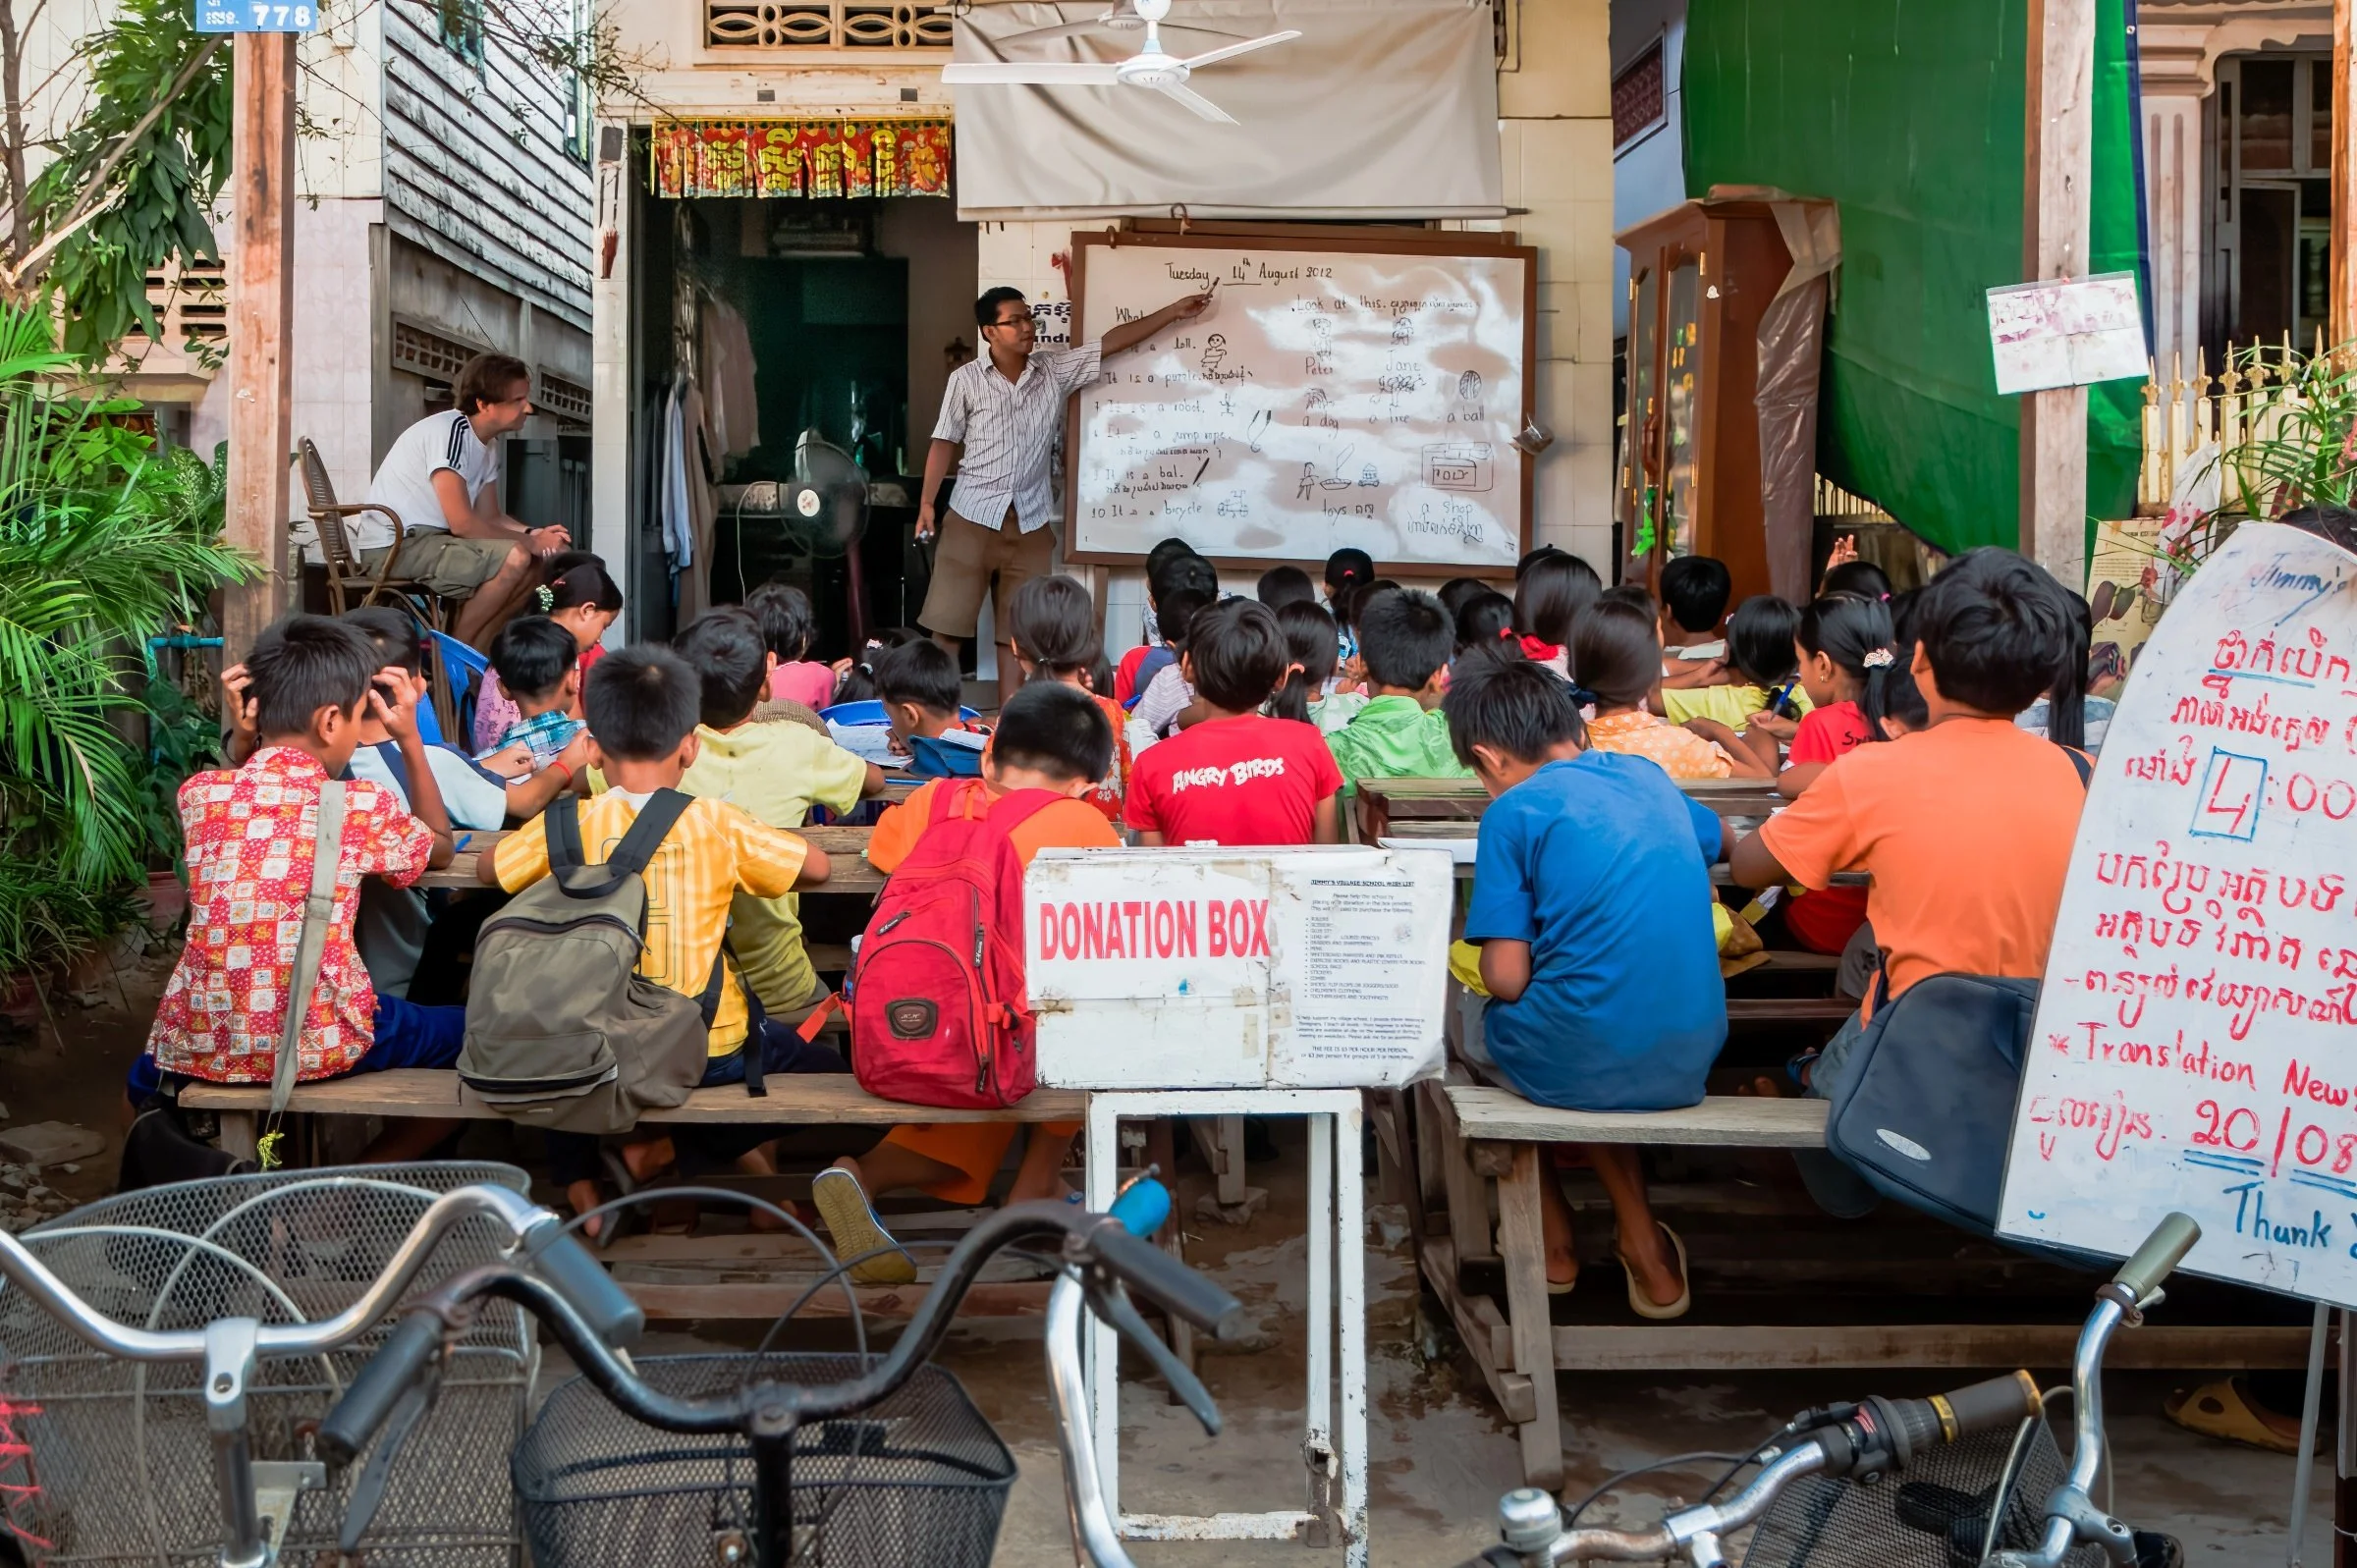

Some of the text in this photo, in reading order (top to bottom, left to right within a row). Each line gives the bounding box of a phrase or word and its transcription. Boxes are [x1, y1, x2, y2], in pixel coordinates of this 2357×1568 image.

[252, 5, 311, 27] 778
[1164, 261, 1210, 291] Tuesday
[1258, 261, 1299, 286] August
[1305, 266, 1333, 279] 2012
[1296, 294, 1324, 311] Look
[1334, 295, 1347, 309] at
[1359, 295, 1387, 309] this.
[1305, 355, 1334, 376] Peter
[1386, 349, 1421, 372] Jane
[1106, 371, 1119, 385] It
[1147, 374, 1155, 383] a
[1157, 404, 1165, 413] a
[1368, 407, 1410, 424] a tree
[1447, 405, 1485, 423] a ball
[1153, 430, 1162, 440] a
[1302, 410, 1340, 439] a dog
[1125, 470, 1134, 480] is
[1091, 508, 1106, 518] 10
[1112, 505, 1123, 517] It
[1164, 500, 1203, 521] bicycle
[1322, 498, 1347, 526] toys
[1421, 494, 1473, 533] a shop
[2250, 552, 2348, 627] Jimmy's
[1172, 756, 1286, 795] ANGRY BIRDS
[1039, 899, 1198, 961] DONATION
[1208, 897, 1272, 958] BOX
[2076, 1020, 2257, 1092] Translation
[2221, 1181, 2332, 1248] Thank
